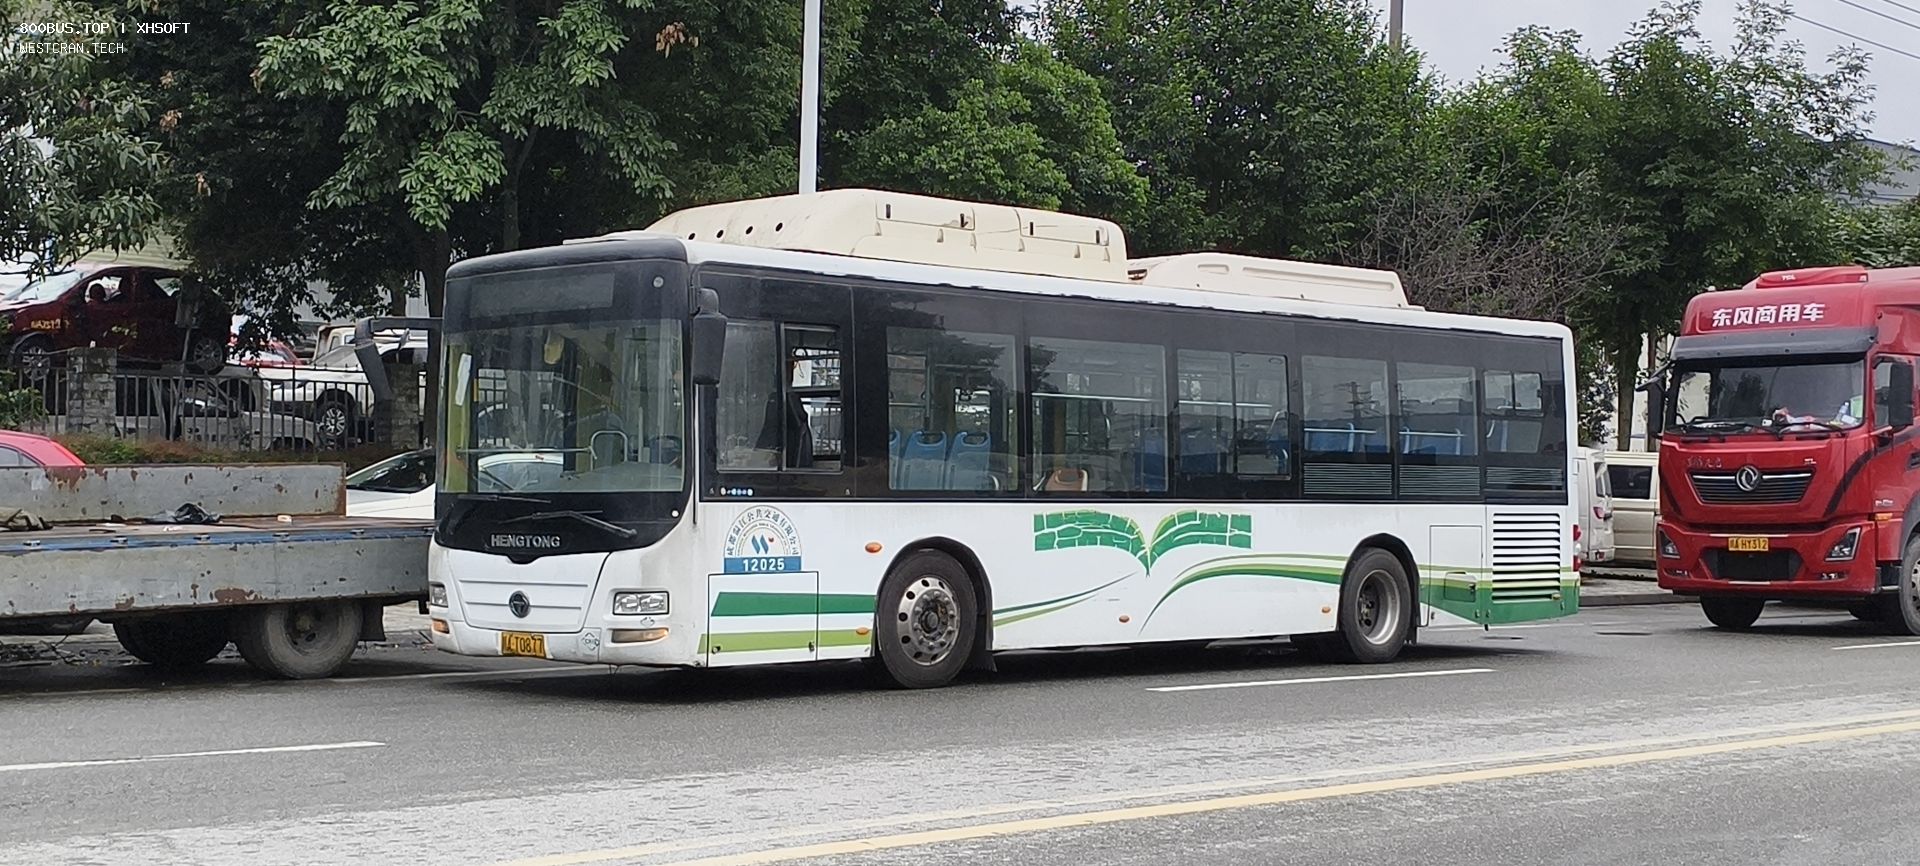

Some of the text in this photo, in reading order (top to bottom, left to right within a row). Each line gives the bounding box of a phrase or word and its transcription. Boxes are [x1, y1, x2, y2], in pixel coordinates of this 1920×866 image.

[1712, 303, 1825, 327] 东风商用车
[491, 534, 561, 548] HENGTONG
[742, 558, 785, 572] 12025
